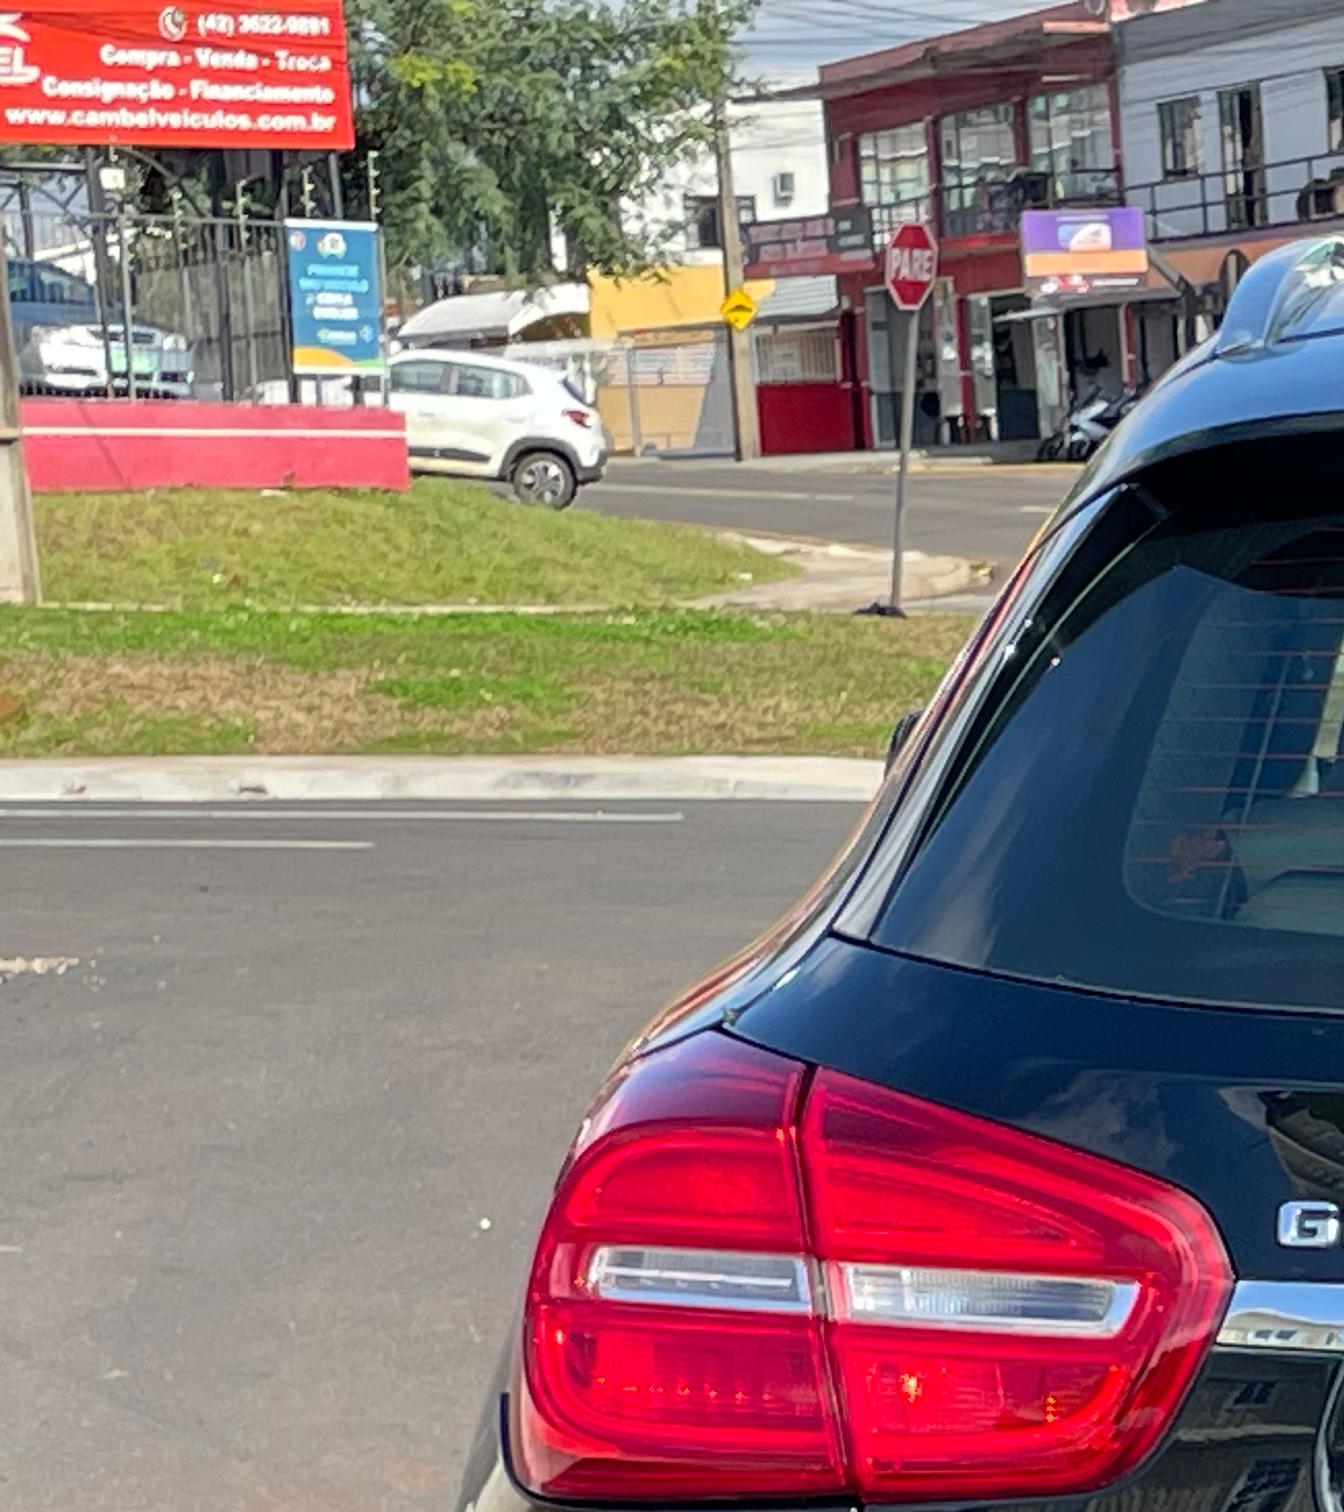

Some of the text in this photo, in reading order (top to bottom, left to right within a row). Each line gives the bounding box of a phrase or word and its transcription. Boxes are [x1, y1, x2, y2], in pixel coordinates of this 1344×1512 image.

[100, 44, 181, 70] Compra
[195, 47, 258, 70] Venda
[275, 50, 331, 72] Troca
[190, 79, 335, 104] Financiamento
[5, 107, 336, 132] www.cambelveiculos.com.br
[891, 247, 934, 280] PARE
